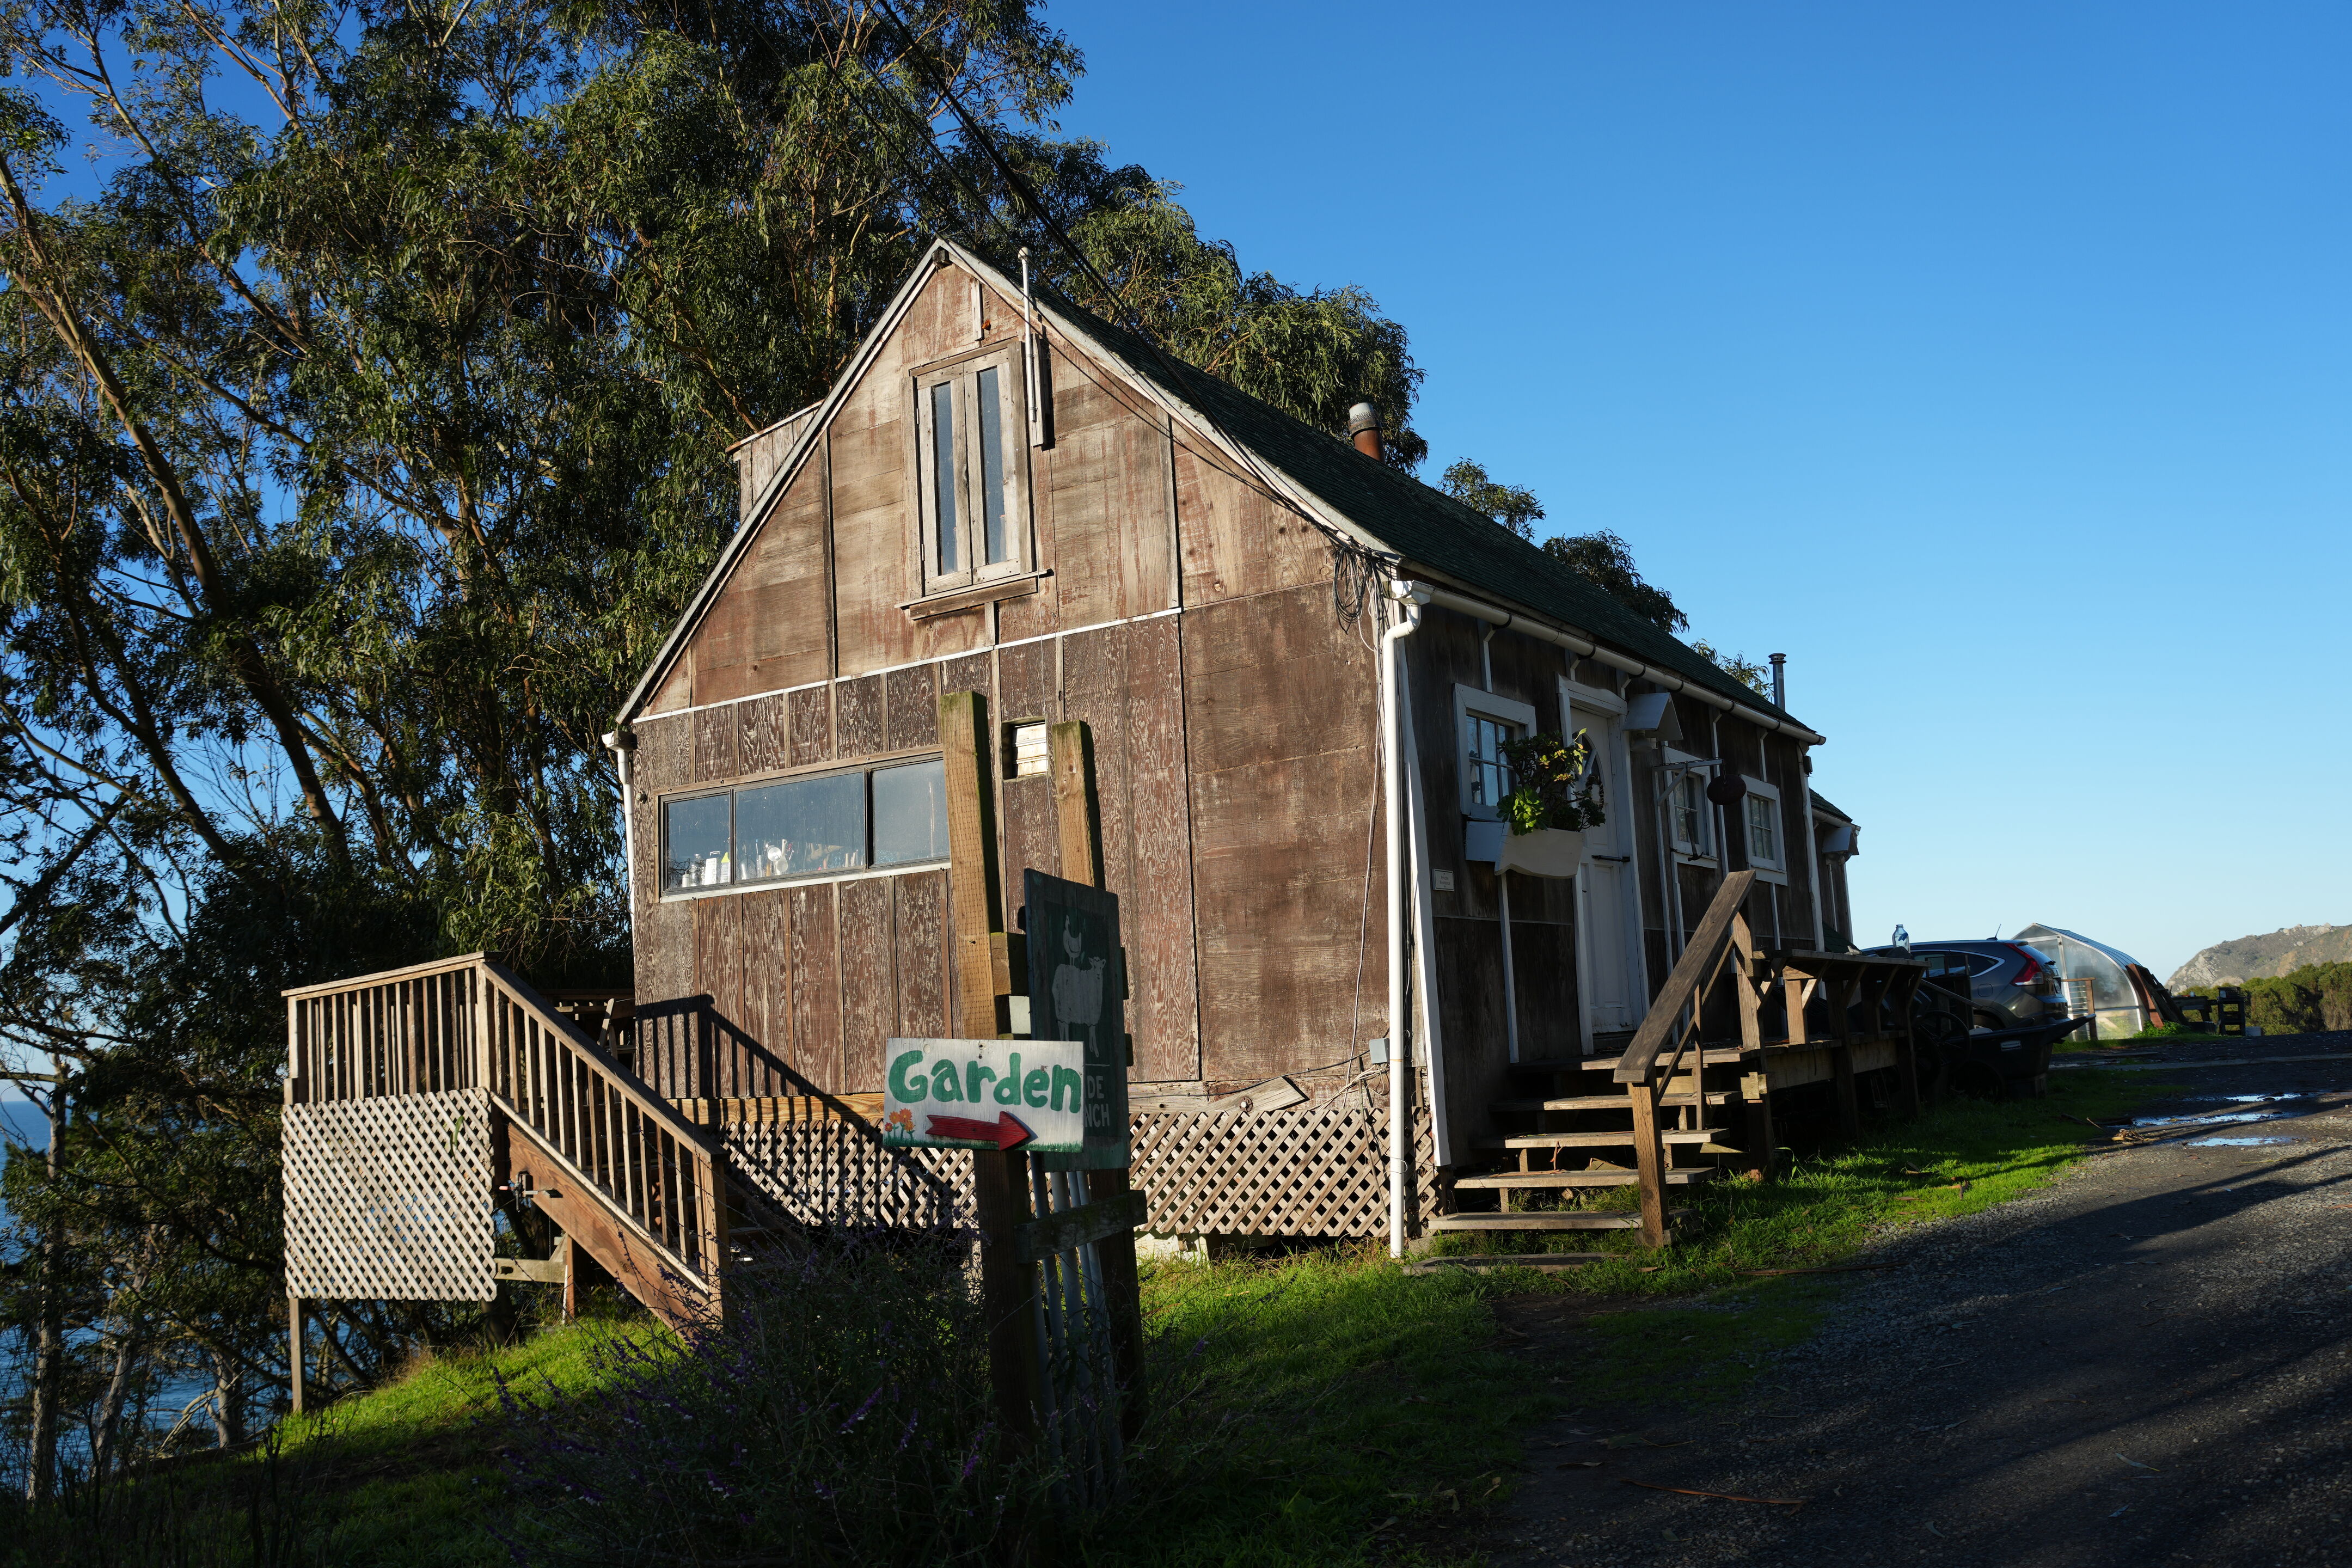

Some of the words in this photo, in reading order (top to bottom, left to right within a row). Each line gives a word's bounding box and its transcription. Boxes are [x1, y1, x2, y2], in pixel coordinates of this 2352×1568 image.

[889, 1050, 1082, 1113] Garden
[1087, 1075, 1104, 1099] DE
[1085, 1103, 1110, 1128] NCH
